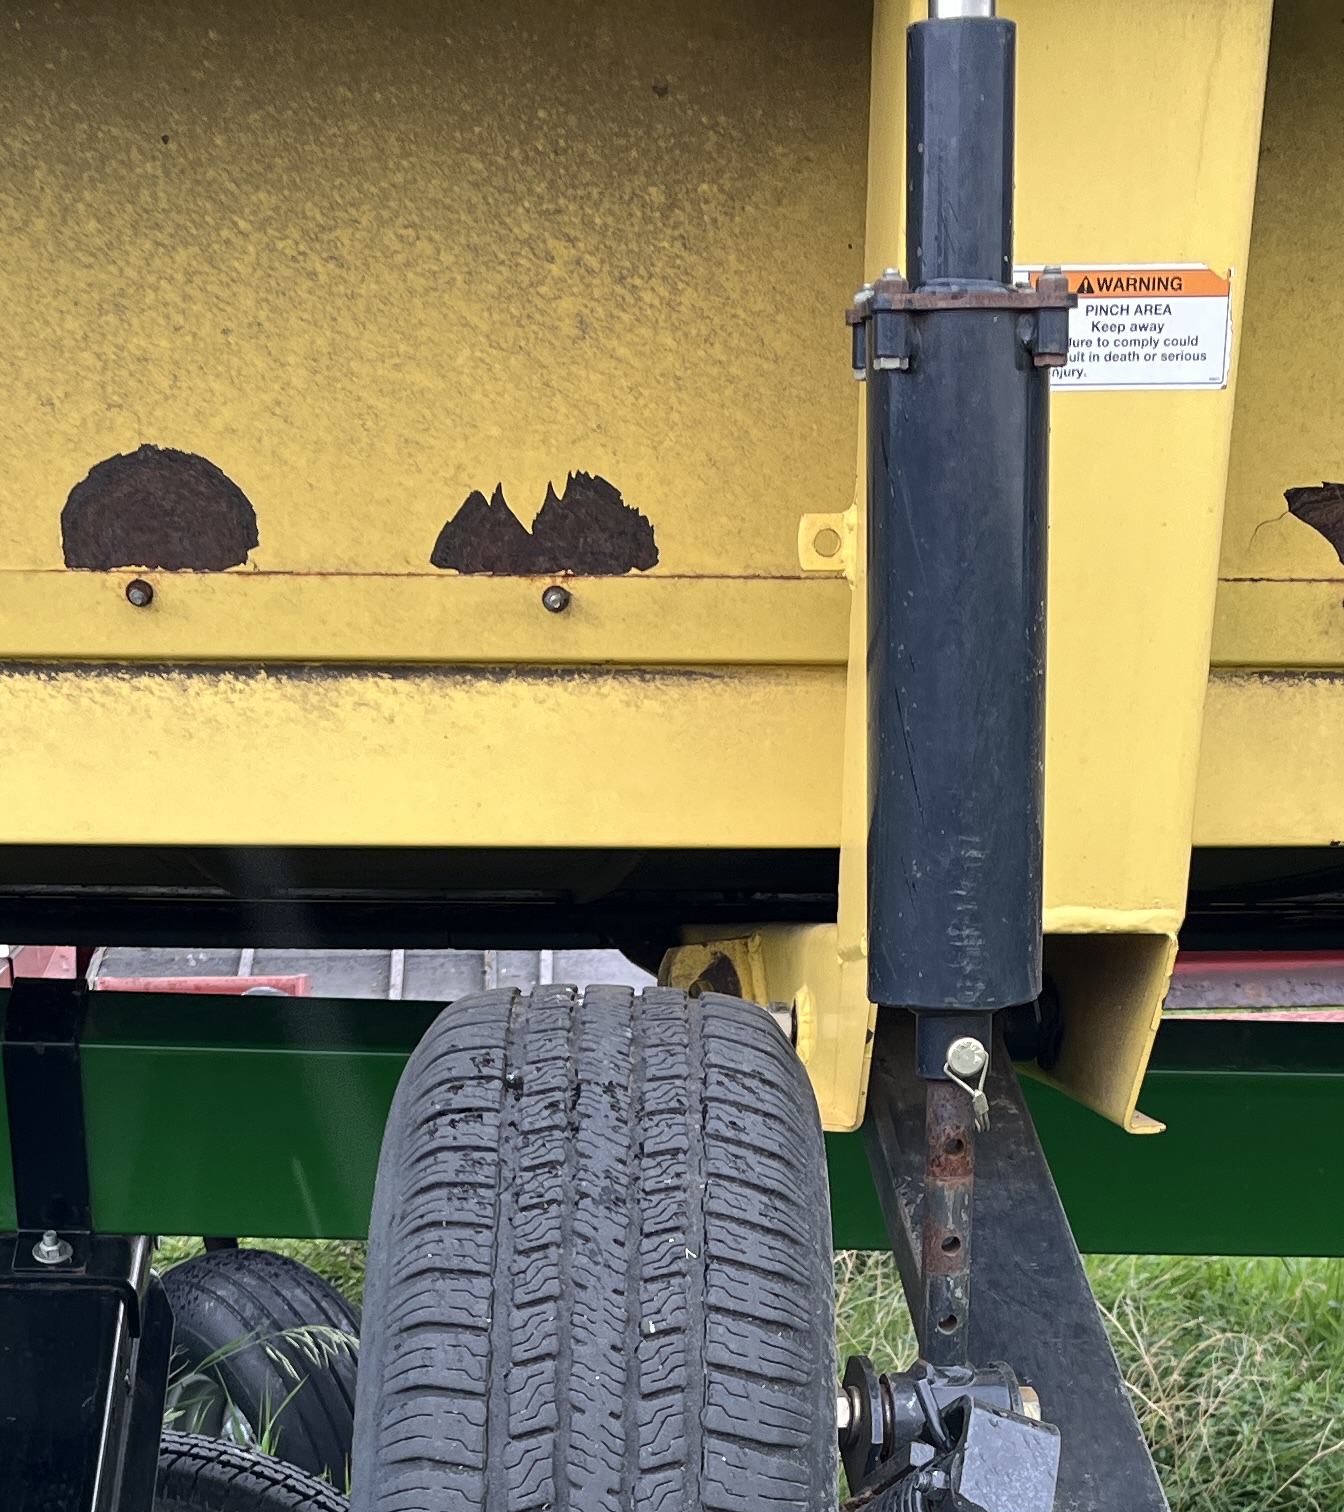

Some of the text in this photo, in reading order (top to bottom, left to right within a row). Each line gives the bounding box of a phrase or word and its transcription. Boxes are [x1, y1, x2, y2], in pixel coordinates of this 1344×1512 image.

[1097, 276, 1183, 292] WARNING
[1085, 303, 1172, 317] PINCH AREA
[1091, 320, 1165, 334] Keep away
[1068, 335, 1199, 350] lure to comply could
[1069, 350, 1207, 363] ult in death or serious
[1050, 368, 1087, 379] njury.
